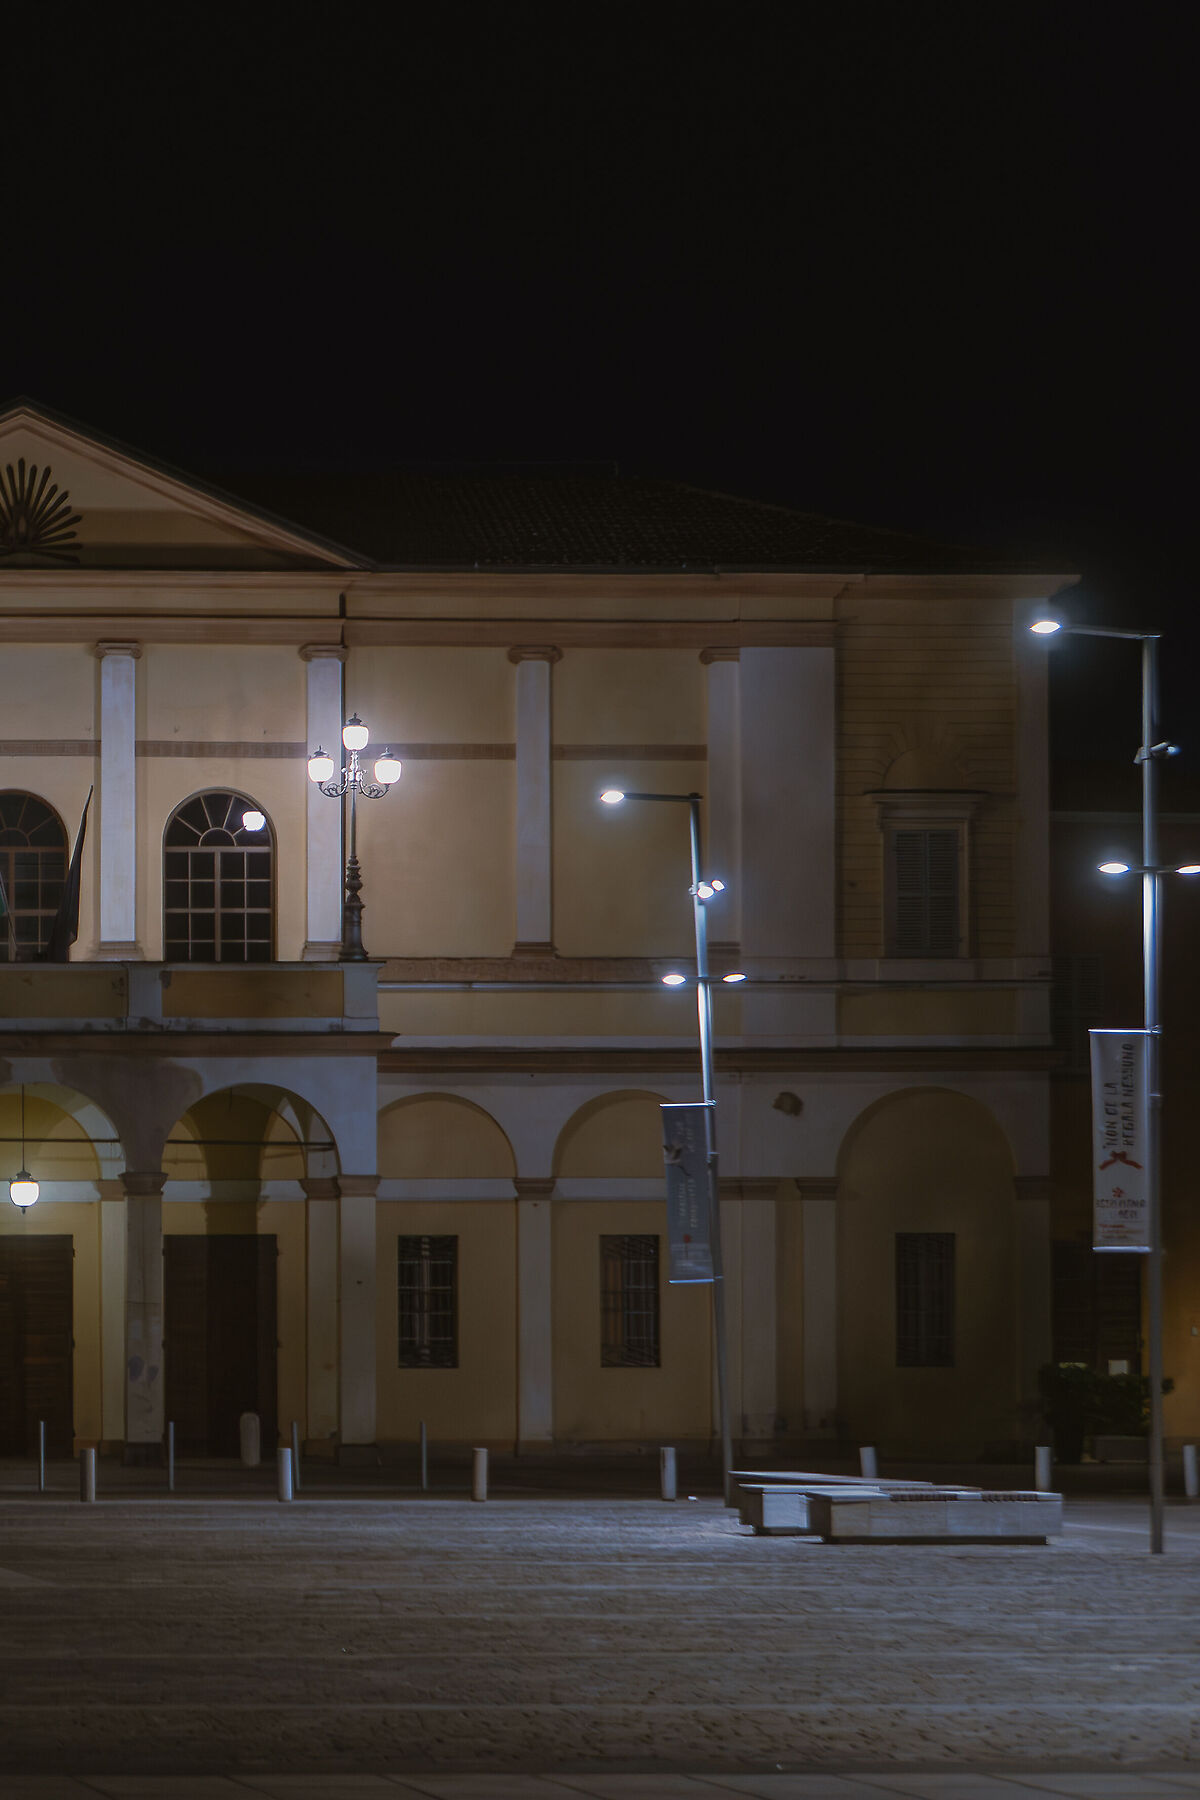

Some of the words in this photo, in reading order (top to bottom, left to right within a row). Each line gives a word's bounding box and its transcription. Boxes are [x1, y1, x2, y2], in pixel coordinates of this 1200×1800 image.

[1103, 1082, 1118, 1095] LA
[1121, 1043, 1134, 1097] NESSUNO
[1121, 1102, 1134, 1146] REGALA
